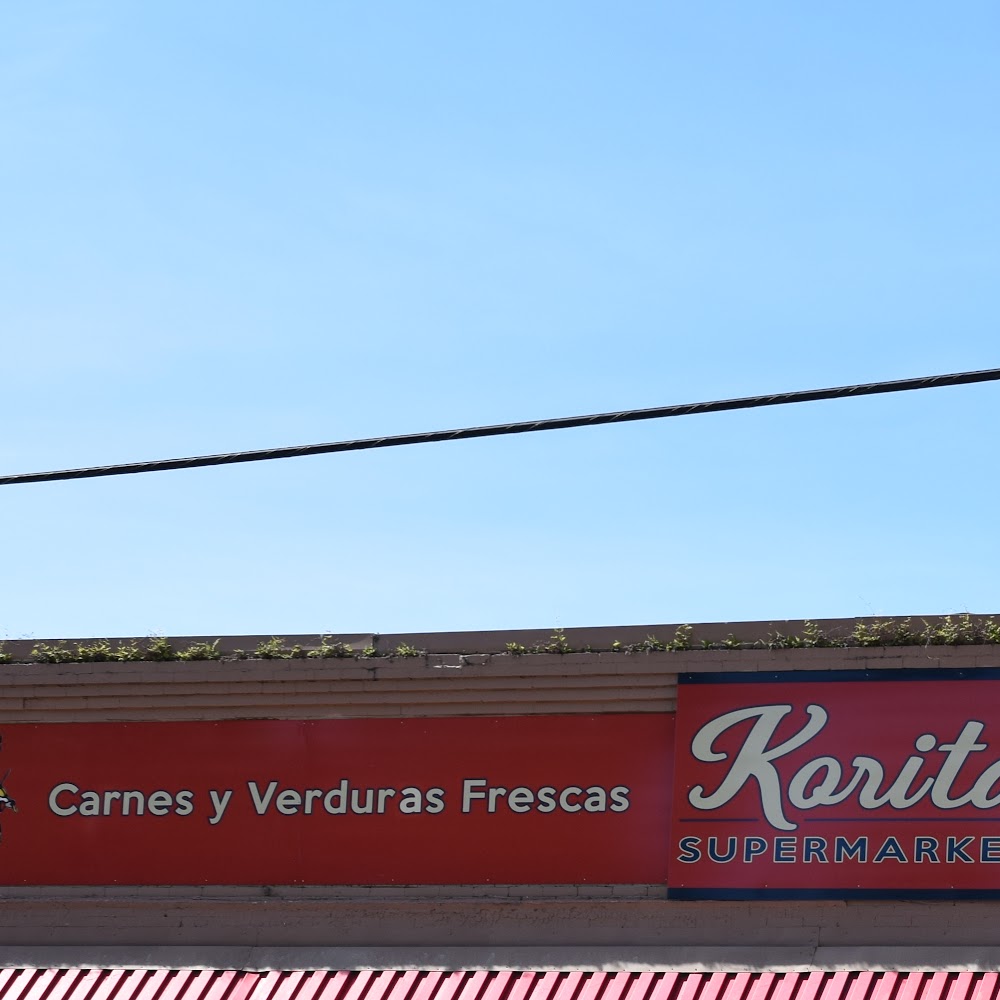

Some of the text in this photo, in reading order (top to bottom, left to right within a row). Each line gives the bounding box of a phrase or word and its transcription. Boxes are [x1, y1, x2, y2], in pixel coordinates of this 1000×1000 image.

[48, 778, 630, 825] Carnes y Verduras Frescas
